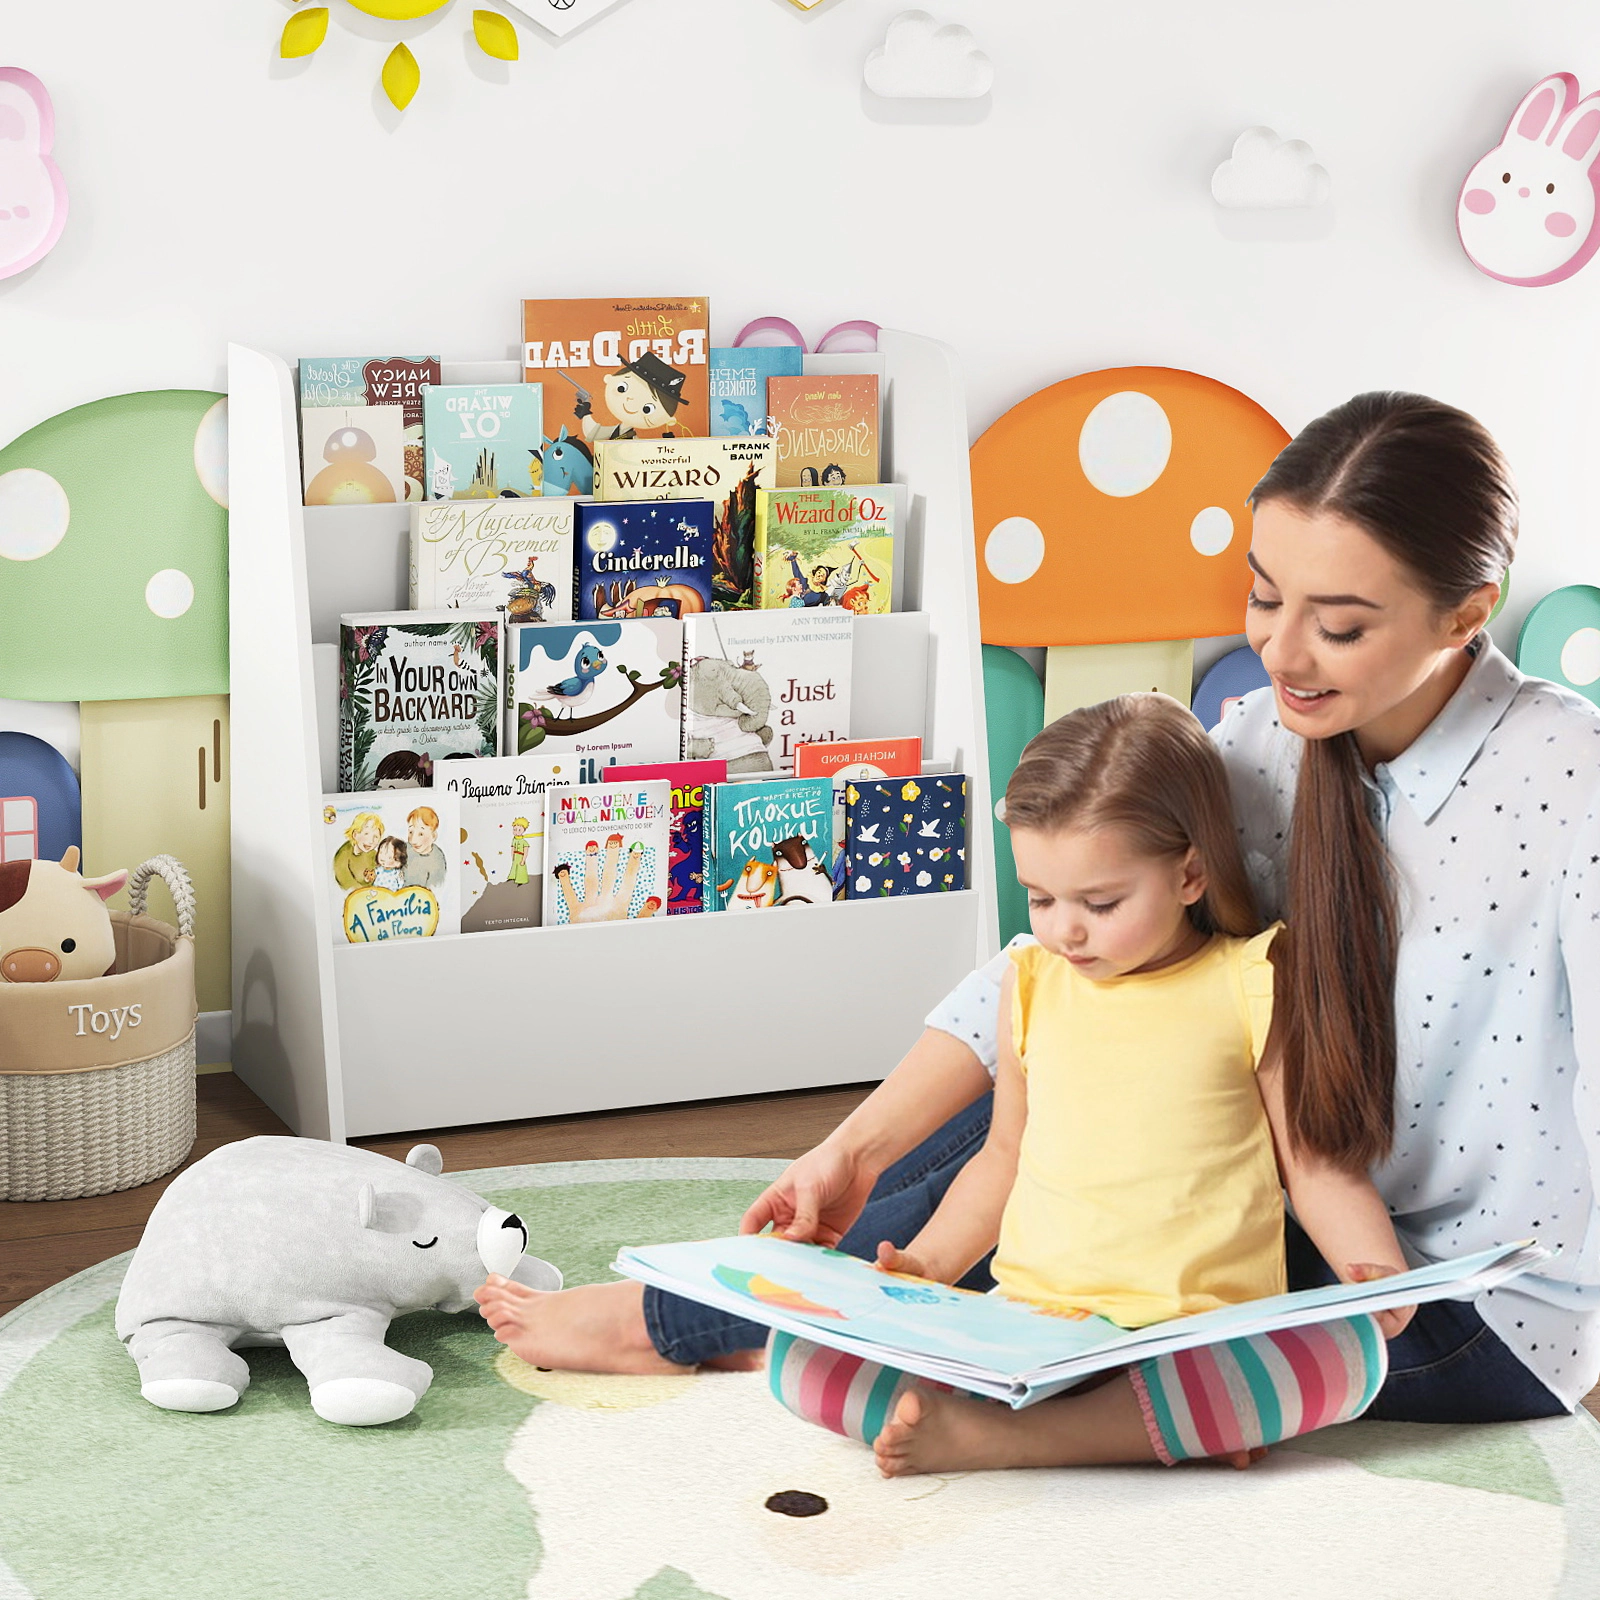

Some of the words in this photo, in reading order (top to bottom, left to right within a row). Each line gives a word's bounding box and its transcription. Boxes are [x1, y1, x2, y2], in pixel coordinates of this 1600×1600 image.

[641, 456, 691, 465] wonderful
[657, 446, 675, 454] The
[614, 465, 720, 488] WIZARD
[799, 494, 822, 502] THE
[425, 504, 456, 535] The
[776, 500, 834, 524] Wizard
[838, 497, 858, 522] of
[859, 498, 886, 521] Oz
[422, 503, 571, 542] Musicians
[440, 538, 472, 572] of
[464, 532, 559, 577] Bremen
[592, 546, 700, 573] Cinderella
[792, 617, 811, 626] ANN
[814, 616, 852, 626] TOMPERT
[404, 639, 426, 648] author
[728, 636, 765, 646] Illustrated
[766, 636, 775, 645] by
[776, 634, 800, 644] LYNN
[800, 632, 852, 643] MUNSINGER
[376, 663, 388, 684] IN
[389, 655, 446, 694] YOUR
[449, 671, 478, 691] OWN
[780, 678, 836, 704] Just
[374, 688, 478, 722] BACKYARD
[780, 709, 796, 726] a
[344, 720, 353, 792] CKYARD
[576, 744, 586, 753] By
[612, 742, 632, 752] Ipsum
[462, 778, 512, 802] Pequeno
[638, 790, 648, 806] É
[792, 790, 822, 799] КЕТРО
[553, 808, 592, 824] IGUAL
[350, 914, 369, 942] A
[366, 893, 432, 926] Família
[378, 928, 388, 941] da
[392, 920, 423, 936] Flora
[68, 1003, 142, 1041] Toys
